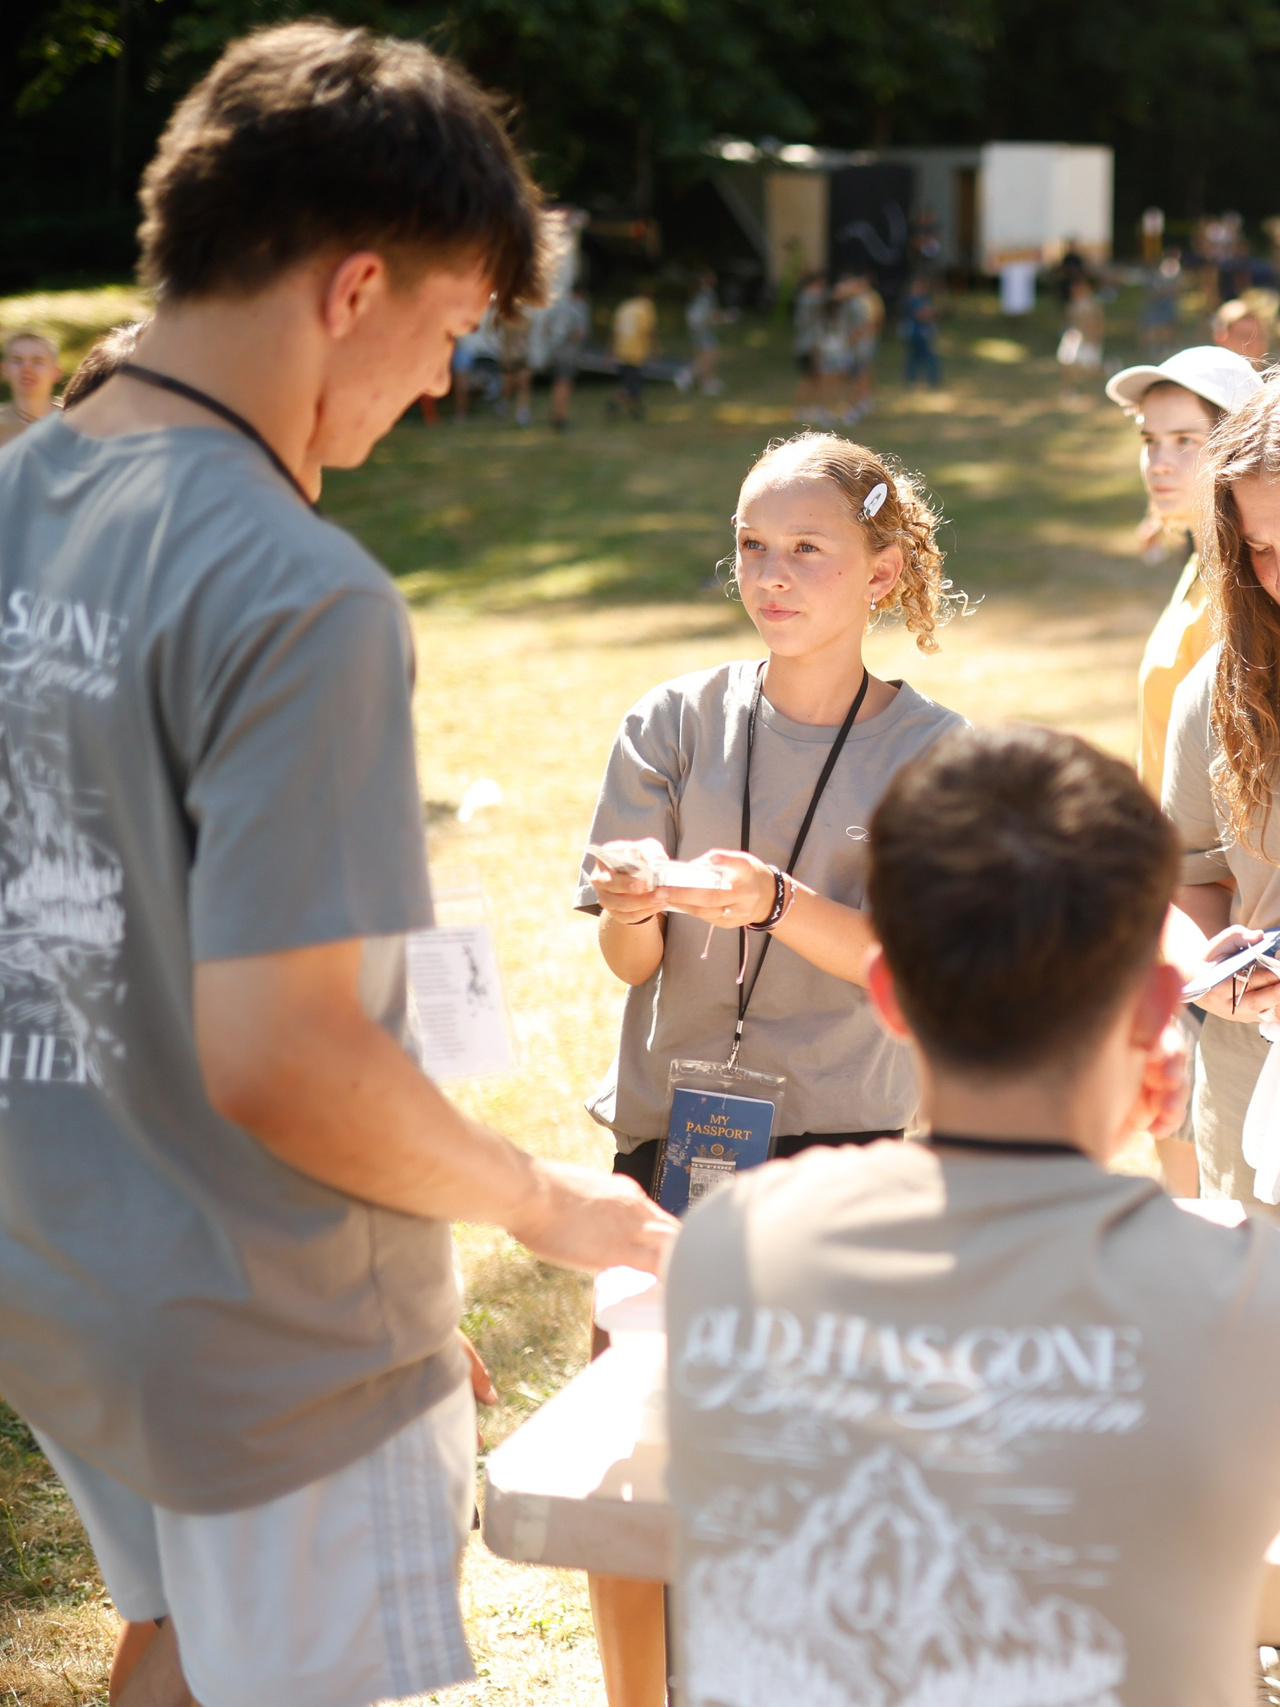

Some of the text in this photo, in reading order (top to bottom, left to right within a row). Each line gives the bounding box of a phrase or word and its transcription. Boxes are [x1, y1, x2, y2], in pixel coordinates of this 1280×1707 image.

[710, 1114, 730, 1126] MY
[686, 1122, 752, 1140] PASSPORT
[948, 1323, 1146, 1394] GONE
